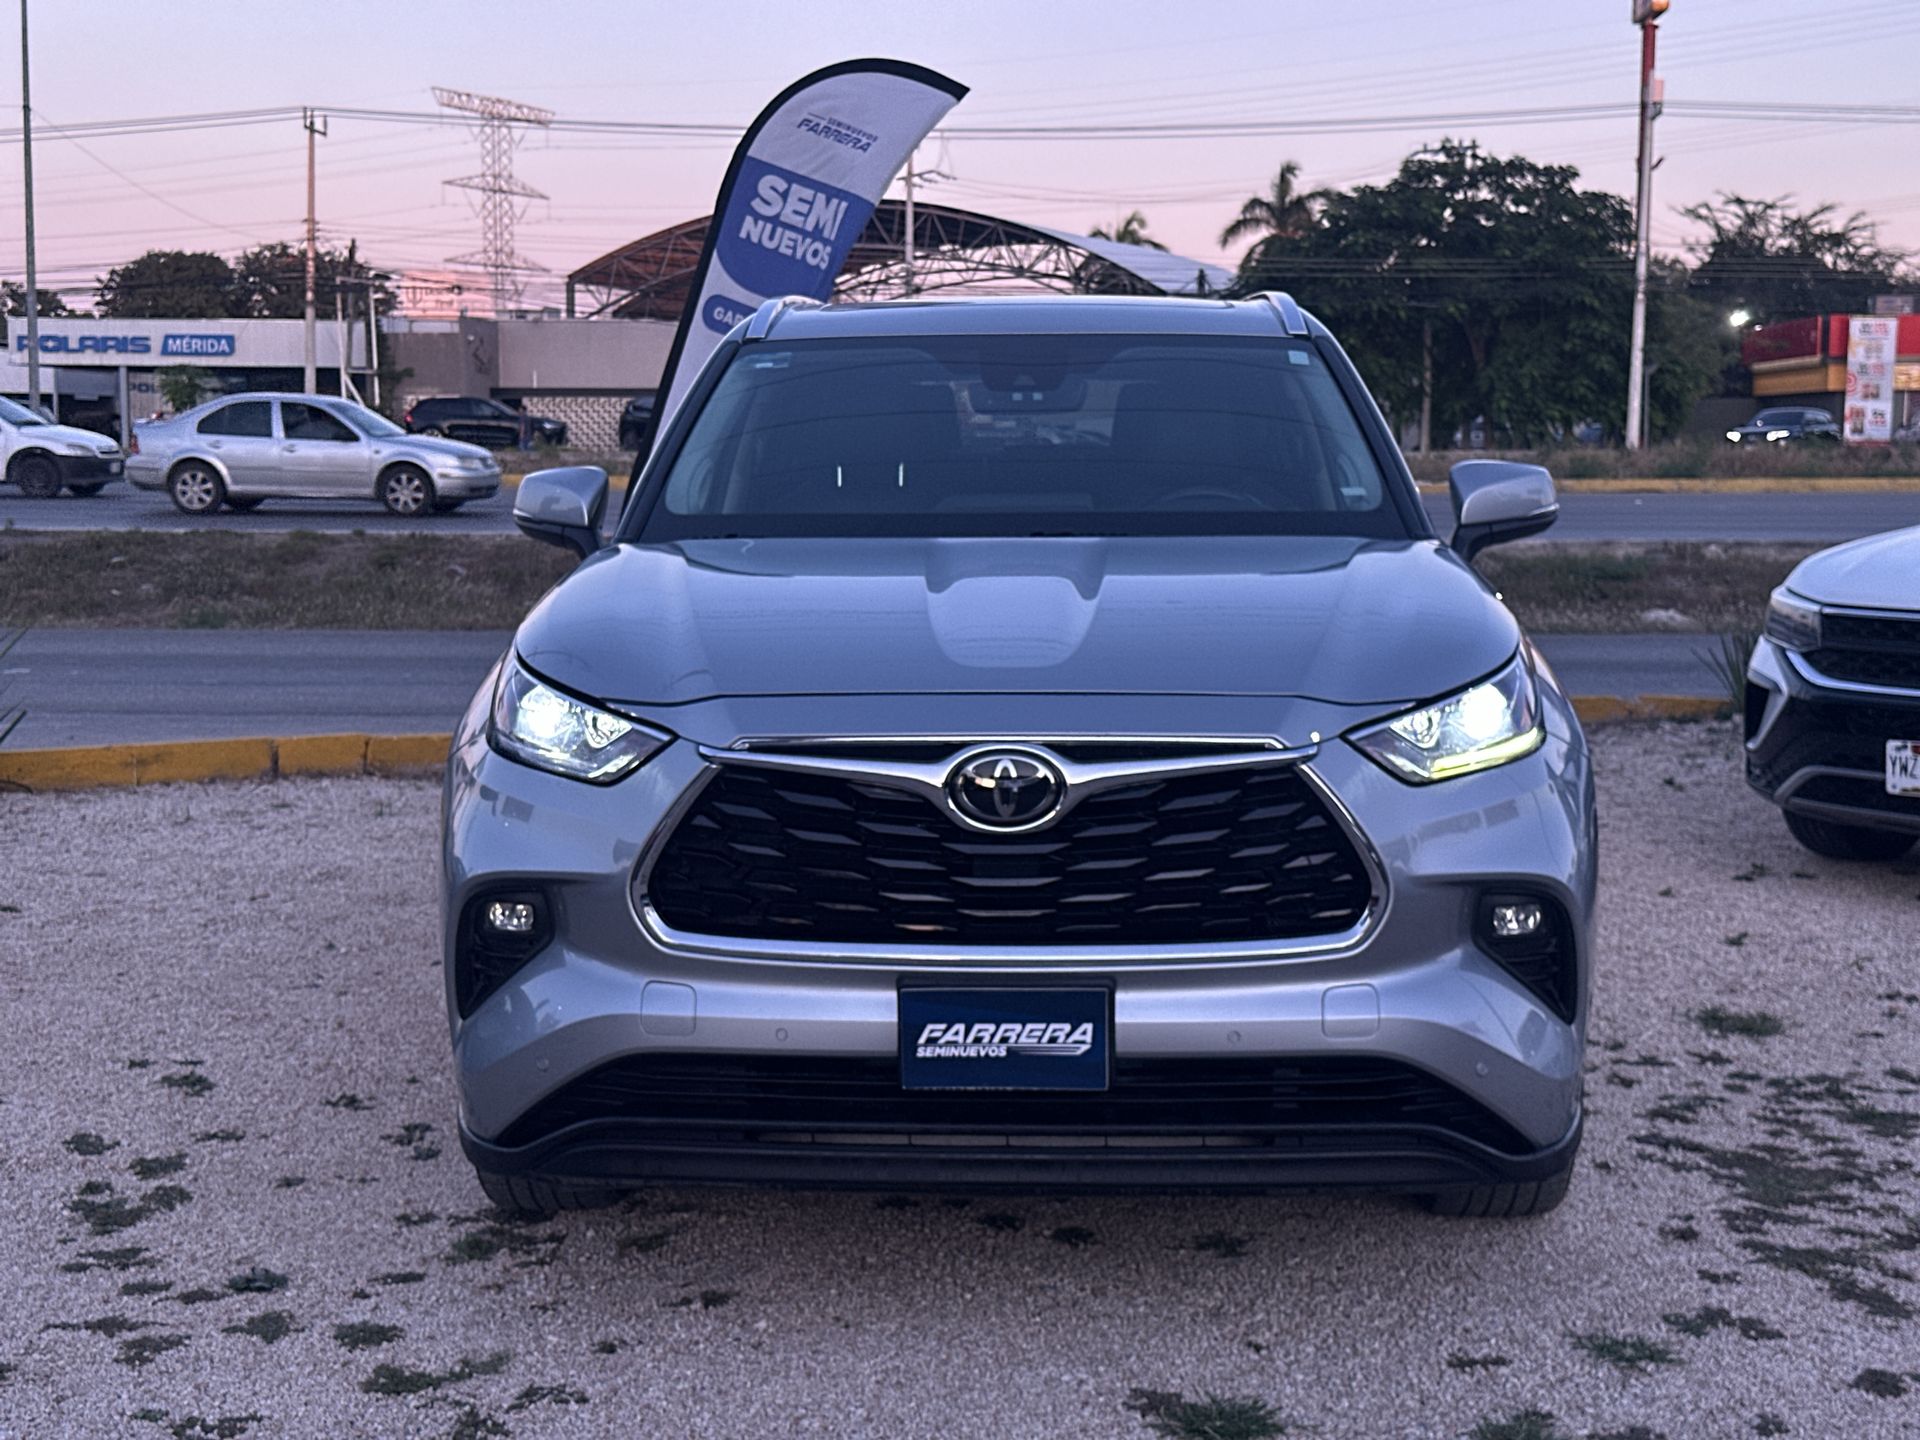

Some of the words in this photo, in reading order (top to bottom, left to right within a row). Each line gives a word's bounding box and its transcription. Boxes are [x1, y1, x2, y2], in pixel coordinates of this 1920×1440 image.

[797, 118, 872, 153] FARRERA
[751, 174, 848, 240] SEMI
[738, 215, 831, 270] NUEVOS
[167, 336, 230, 353] MÉRIDA
[917, 1022, 1094, 1045] FARRERA
[916, 1046, 1008, 1058] SEMINUEVOS
